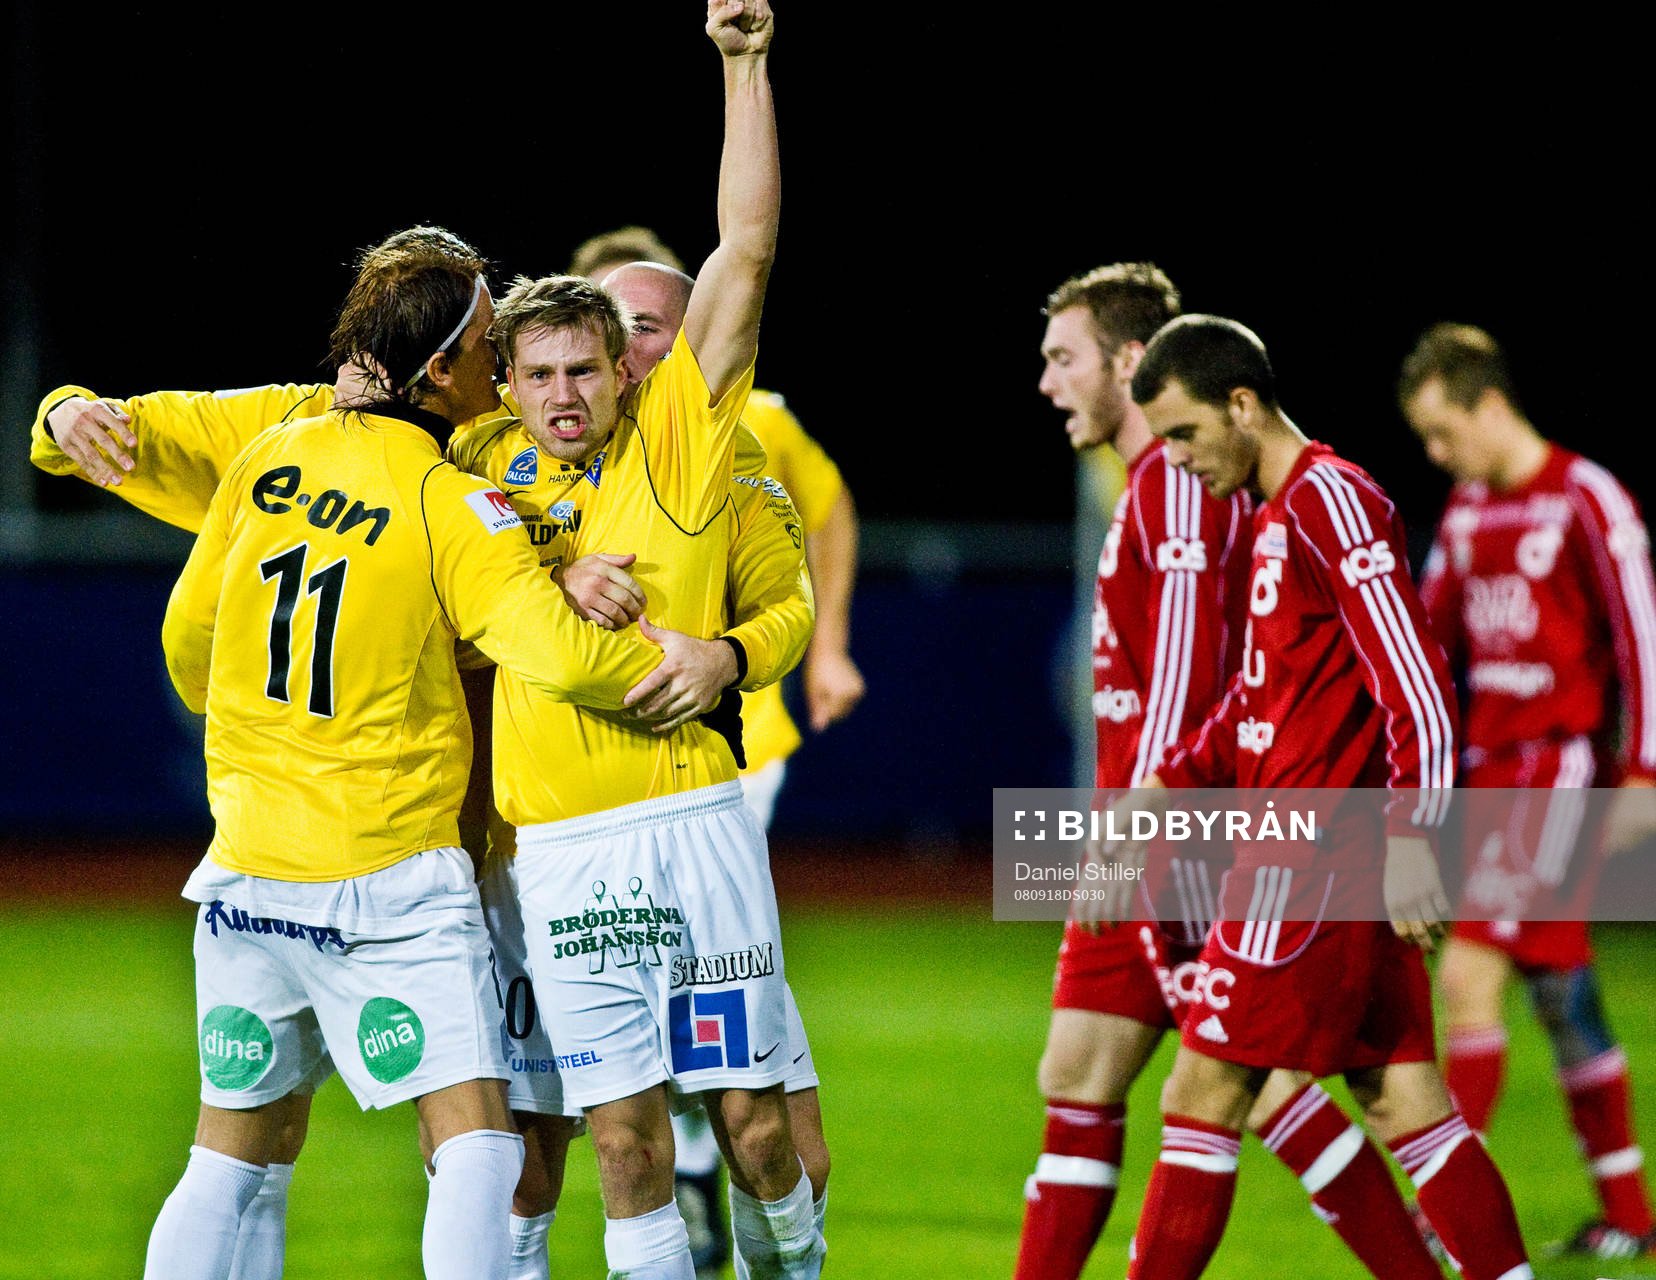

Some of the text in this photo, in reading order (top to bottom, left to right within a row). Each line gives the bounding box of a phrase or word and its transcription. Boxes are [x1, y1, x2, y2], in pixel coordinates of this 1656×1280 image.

[506, 470, 537, 483] FALCON
[258, 540, 350, 718] 11
[548, 906, 685, 937] BRÖDERNA
[553, 930, 683, 959] JOHANSSON
[669, 942, 775, 989] STADIUM
[205, 1028, 265, 1061] dina
[363, 1021, 417, 1060] dina
